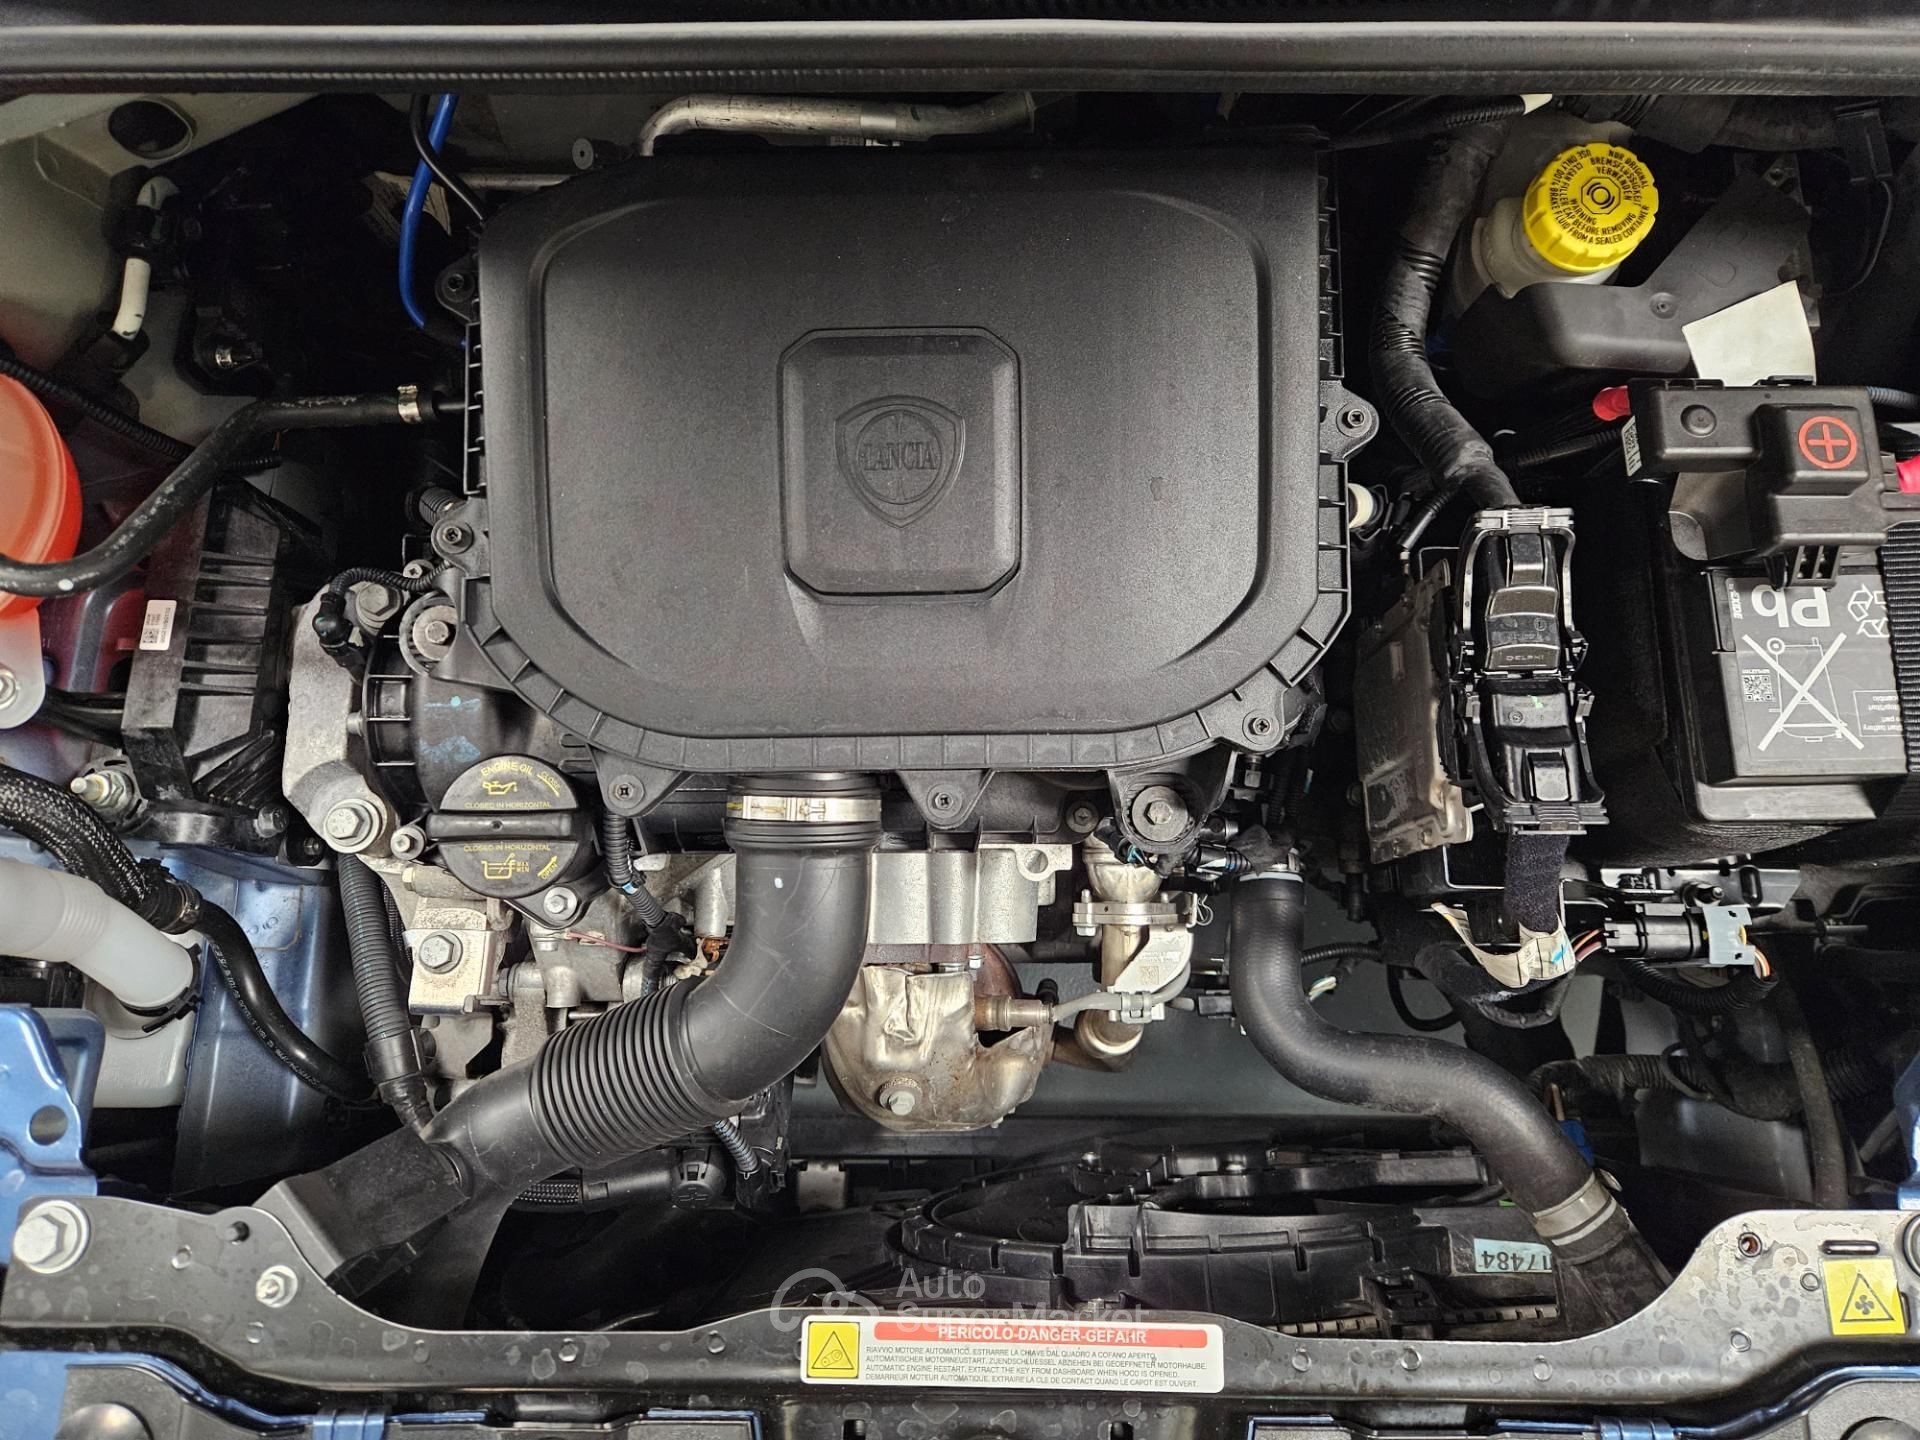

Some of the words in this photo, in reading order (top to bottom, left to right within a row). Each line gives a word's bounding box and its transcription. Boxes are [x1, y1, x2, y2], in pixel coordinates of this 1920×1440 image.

[1577, 149, 1592, 159] USE
[1562, 155, 1578, 172] ONLY
[1564, 162, 1583, 183] CLEAN
[1625, 158, 1649, 188] ORIGINAL
[1596, 167, 1632, 200] VERWENDEN
[1549, 187, 1559, 210] BRAKE
[1560, 183, 1569, 205] FILLER
[1554, 211, 1569, 229] FLUID
[1562, 205, 1576, 220] CAP
[1570, 198, 1597, 225] WARNING
[1572, 218, 1600, 235] BEFORE
[1602, 212, 1636, 235] REMOVING
[1622, 205, 1649, 238] CONTAINER
[1568, 228, 1588, 242] FROM
[1595, 236, 1622, 245] SEALED
[863, 442, 937, 470] LANCIA
[1751, 584, 1831, 628] Pb
[480, 761, 518, 776] ENGINE
[519, 764, 534, 776] OIL
[541, 864, 558, 880] OPEN
[938, 1325, 1147, 1344] PERICOLO-DANGER-GEFAHR
[866, 1346, 894, 1354] RIAVVIO
[895, 1346, 925, 1354] MOTORE
[973, 1348, 1009, 1356] ESTRARRE
[1020, 1349, 1046, 1357] CHIAVE
[1061, 1350, 1090, 1358] QUADRO
[1098, 1351, 1126, 1359] COFANO
[968, 1366, 1000, 1374] EXTRACT
[1053, 1368, 1096, 1376] DASHBOARD
[989, 1357, 1057, 1366] ZUENDSCHLUESSEL
[1058, 1359, 1091, 1367] ABZIEHEN
[1105, 1360, 1156, 1368] GEOEFFNETER
[1157, 1362, 1207, 1370] MOTORHAUBE.
[992, 1375, 1024, 1383] EXTRAIRE
[1035, 1376, 1049, 1384] CLE
[1061, 1377, 1094, 1385] CONTACT
